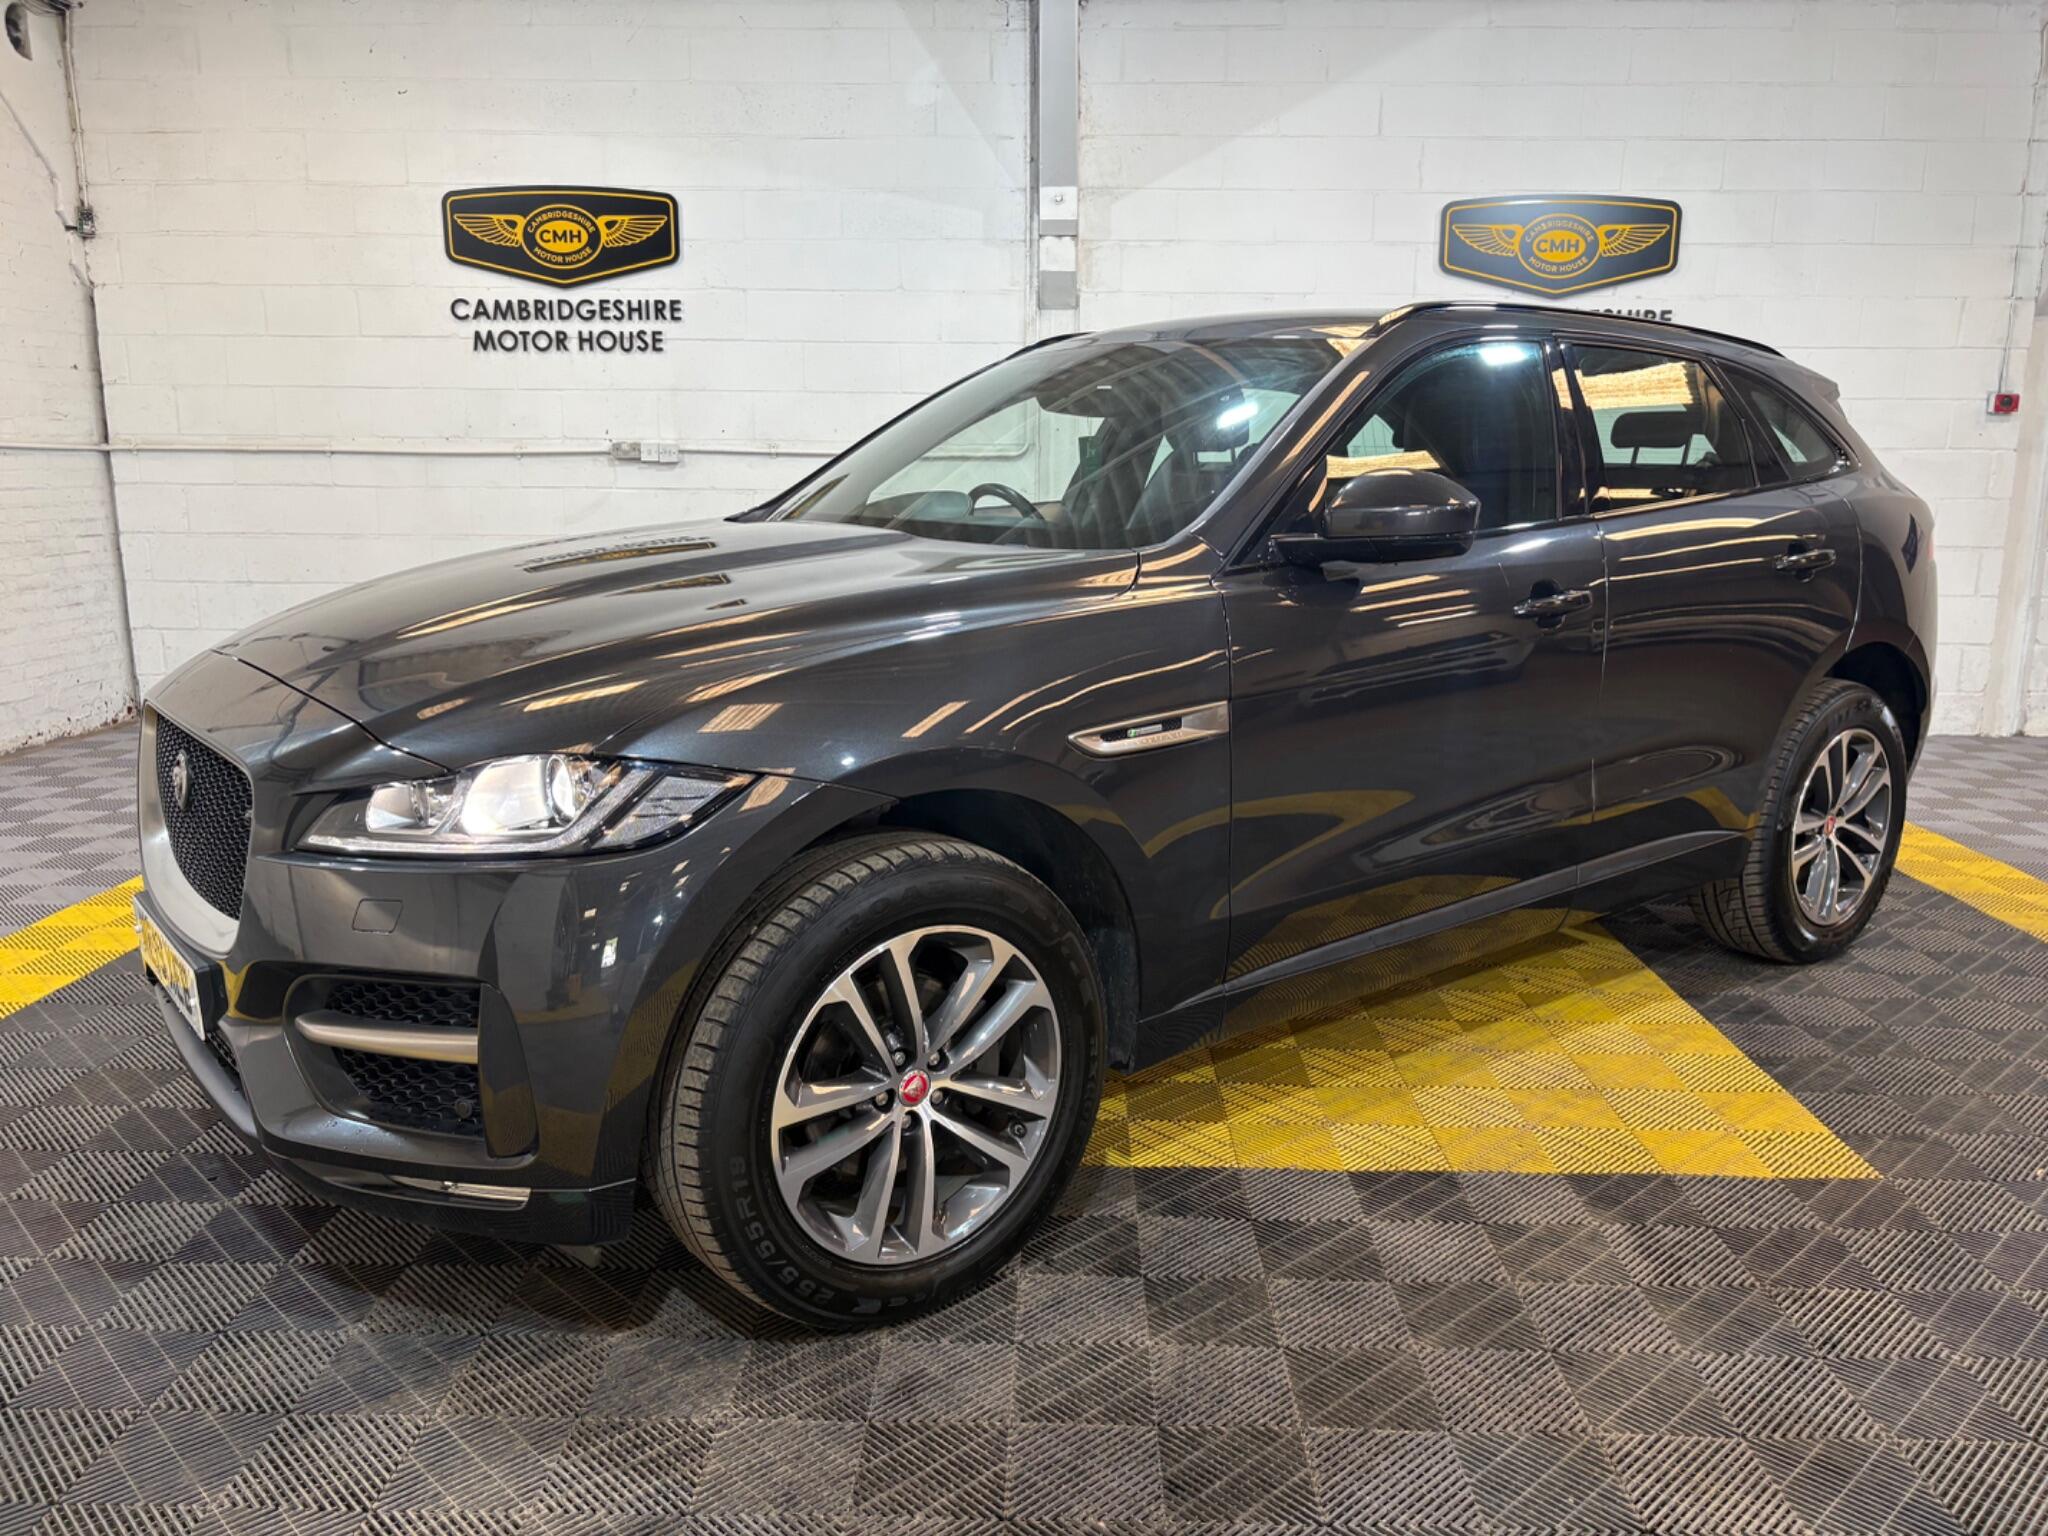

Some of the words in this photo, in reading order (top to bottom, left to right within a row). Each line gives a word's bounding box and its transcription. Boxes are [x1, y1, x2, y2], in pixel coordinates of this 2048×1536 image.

[528, 210, 596, 233] CAMBRIDGESHIRE
[540, 229, 582, 243] CMH
[1536, 239, 1580, 253] CMH
[533, 246, 564, 263] MOTOR
[564, 246, 593, 263] HOUSE
[1528, 256, 1558, 272] MOTOR
[1559, 256, 1589, 272] HOUSE
[450, 298, 683, 322] CAMBRIDGESHIRE
[473, 329, 569, 352] MOTOR
[579, 329, 665, 352] HOUSE
[728, 1155, 836, 1305] 255/55R19
